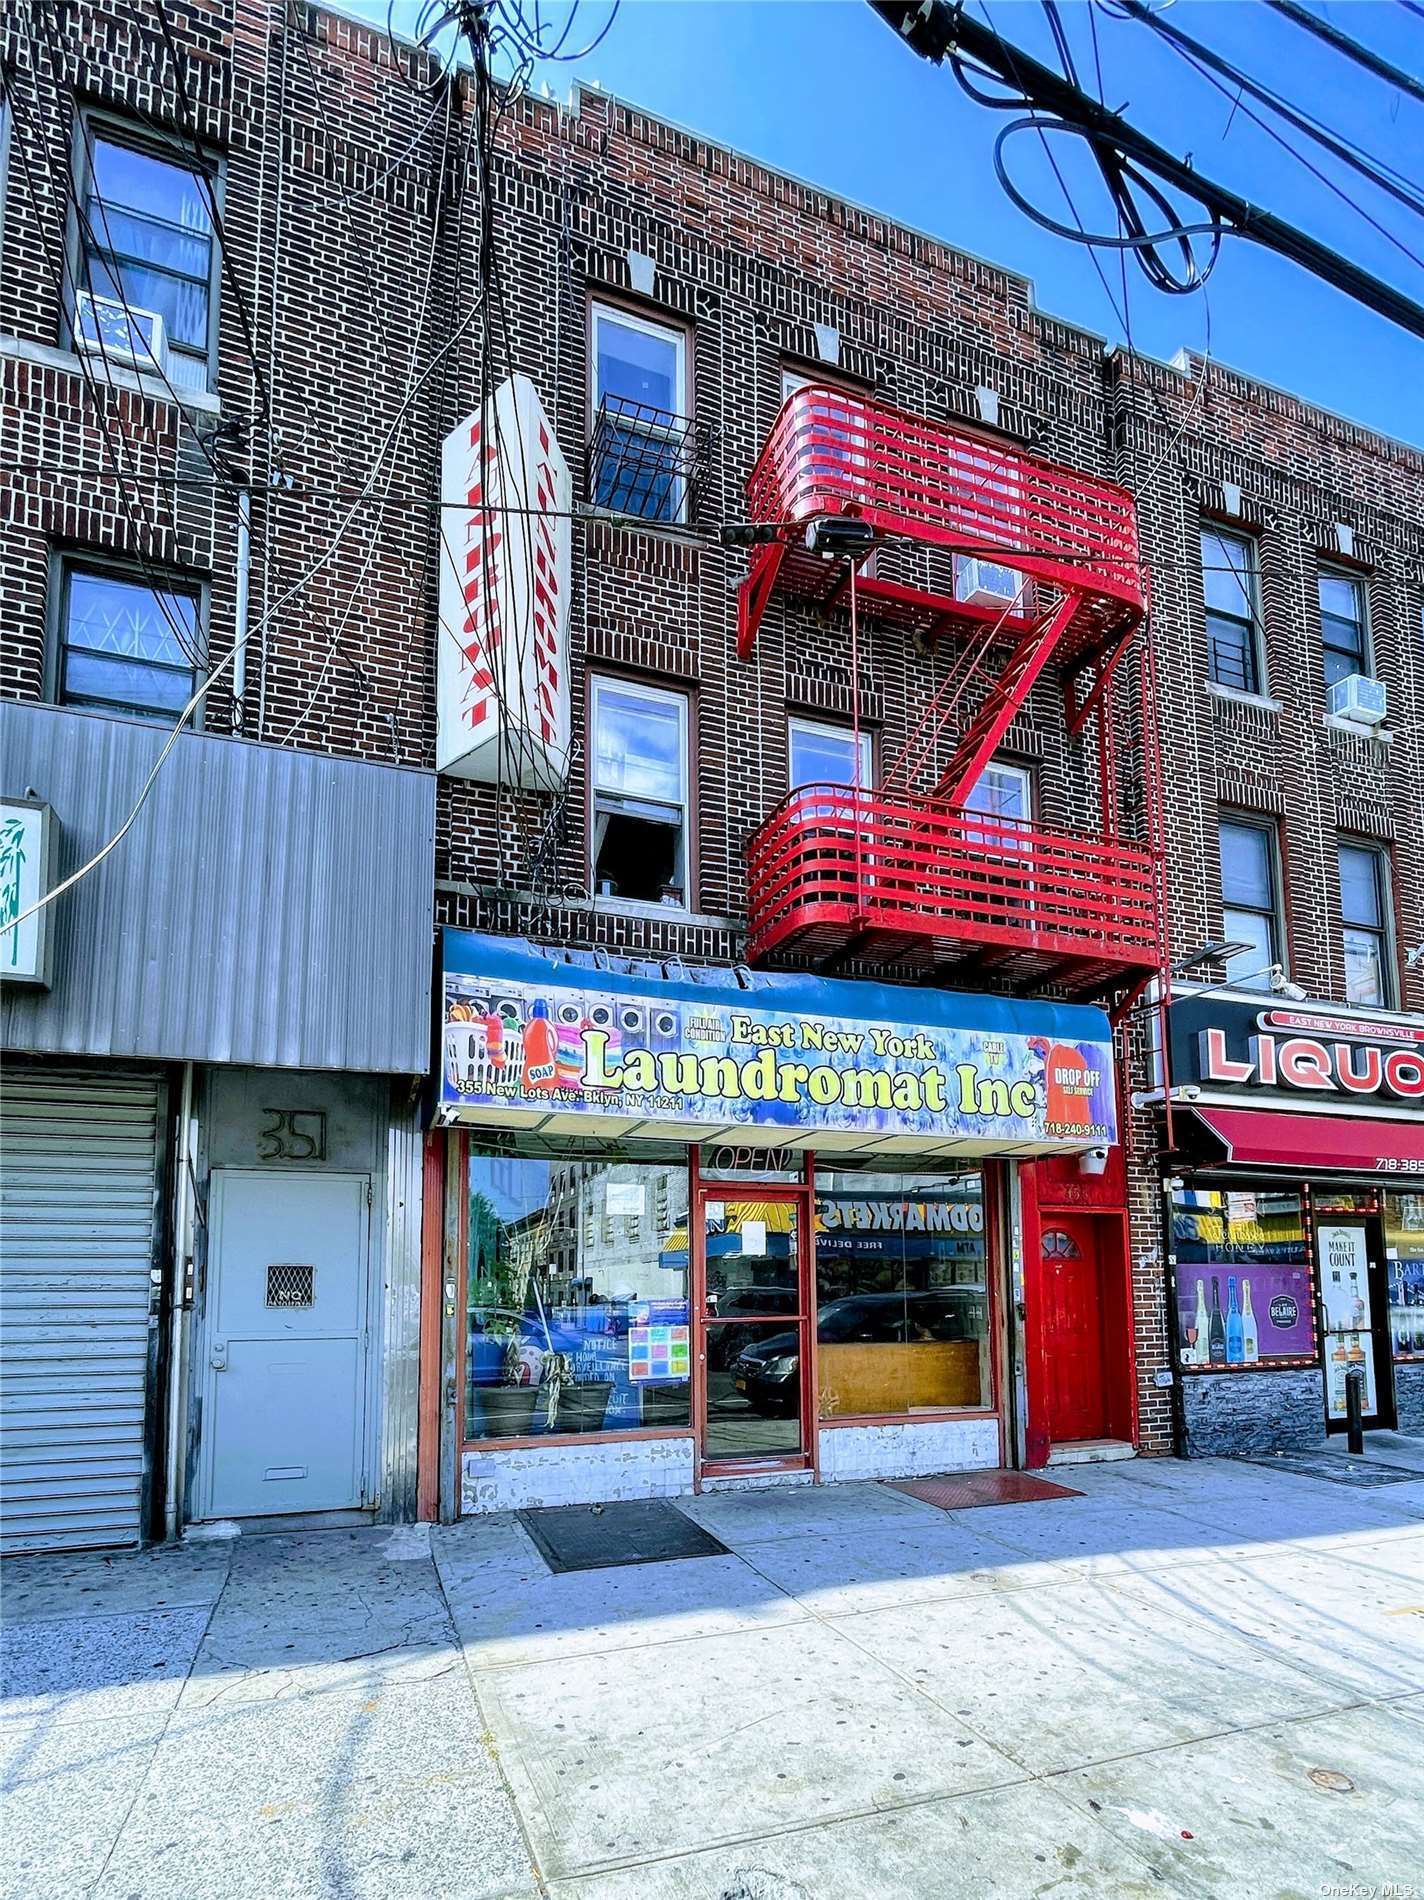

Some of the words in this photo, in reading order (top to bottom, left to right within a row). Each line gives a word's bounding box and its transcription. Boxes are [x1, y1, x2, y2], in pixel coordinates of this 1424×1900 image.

[684, 1027, 726, 1042] CONDITION
[1289, 1016, 1312, 1027] EAST
[1314, 1020, 1333, 1030] NEW
[1334, 1022, 1357, 1033] YORK
[1359, 1025, 1415, 1039] BROWNSVILLE
[731, 1015, 796, 1048] East
[800, 1022, 864, 1054] New
[869, 1029, 937, 1060] York
[983, 1041, 1005, 1054] CABLE
[529, 1064, 554, 1080] SOAP
[1206, 1028, 1424, 1098] LIQUO
[581, 1030, 947, 1113] Laundromat
[957, 1064, 1037, 1118] Inc
[1055, 1068, 1082, 1086] DROP
[1083, 1070, 1101, 1088] OFF
[457, 1081, 482, 1094] 355
[486, 1083, 517, 1097] New
[520, 1086, 549, 1100] Lots
[584, 1091, 623, 1109] Bklyn,
[626, 1096, 645, 1108] NY
[648, 1096, 684, 1110] 11211
[257, 1108, 327, 1160] 351
[1044, 1121, 1108, 1137] 718-240-9111
[715, 1146, 786, 1174] OPEN
[1328, 1241, 1347, 1253] MAKE
[1348, 1241, 1355, 1252] IT
[1329, 1253, 1355, 1267] COUNT
[1270, 1306, 1297, 1317] BELAIRE
[584, 1338, 617, 1351] NOTICE
